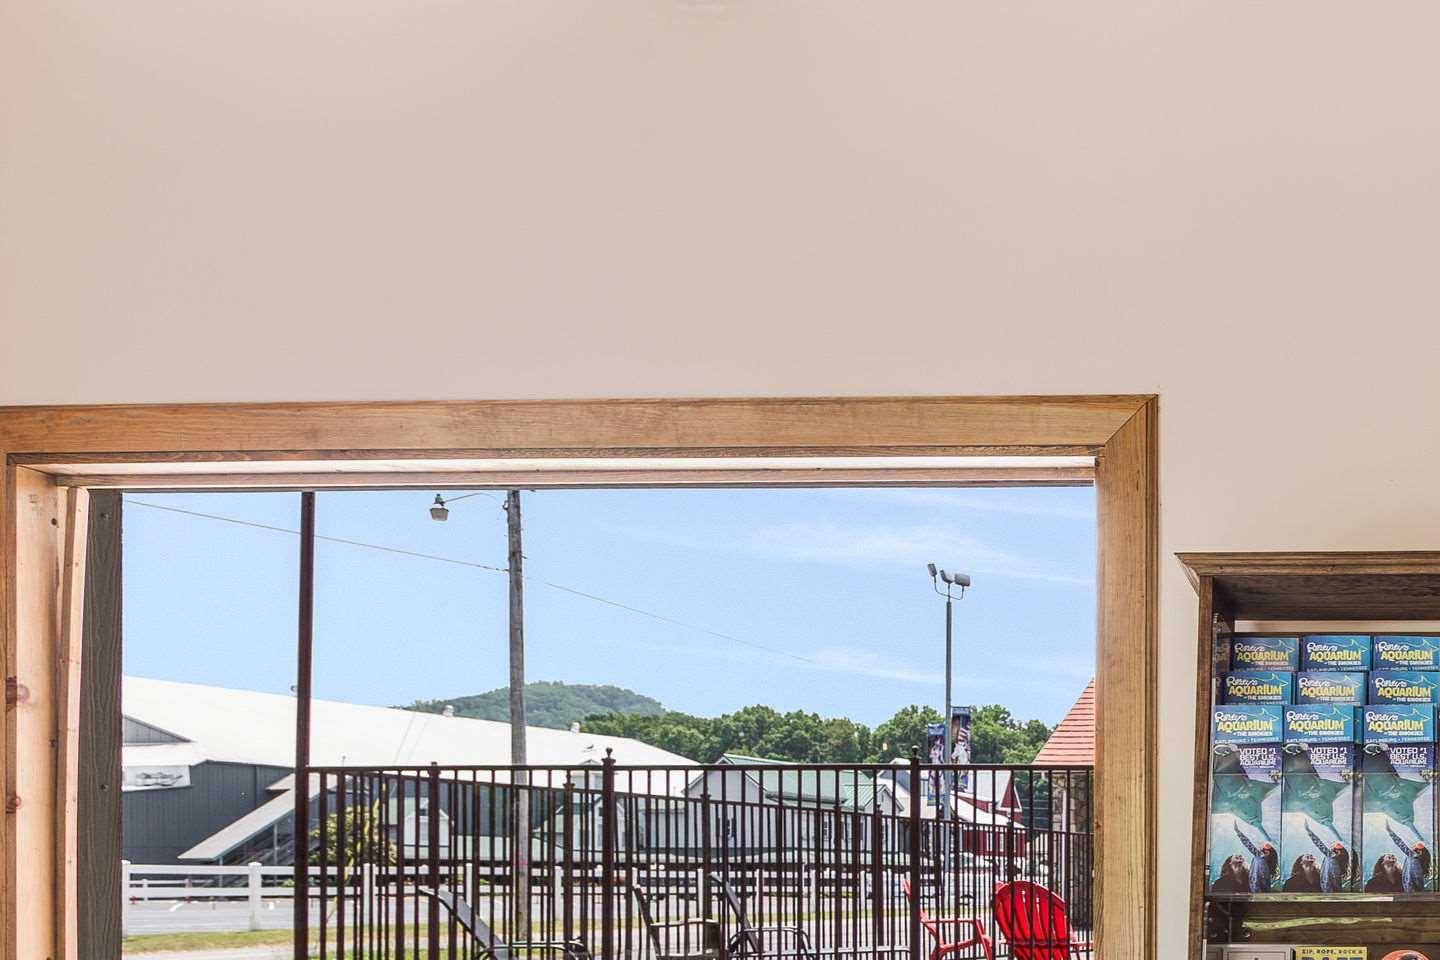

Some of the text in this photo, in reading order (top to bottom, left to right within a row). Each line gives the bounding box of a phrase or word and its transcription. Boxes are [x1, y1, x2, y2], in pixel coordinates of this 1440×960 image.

[1237, 652, 1288, 661] AQUARIUM
[1310, 652, 1361, 661] AQUARIUM
[1381, 652, 1432, 660] AQUARIUM
